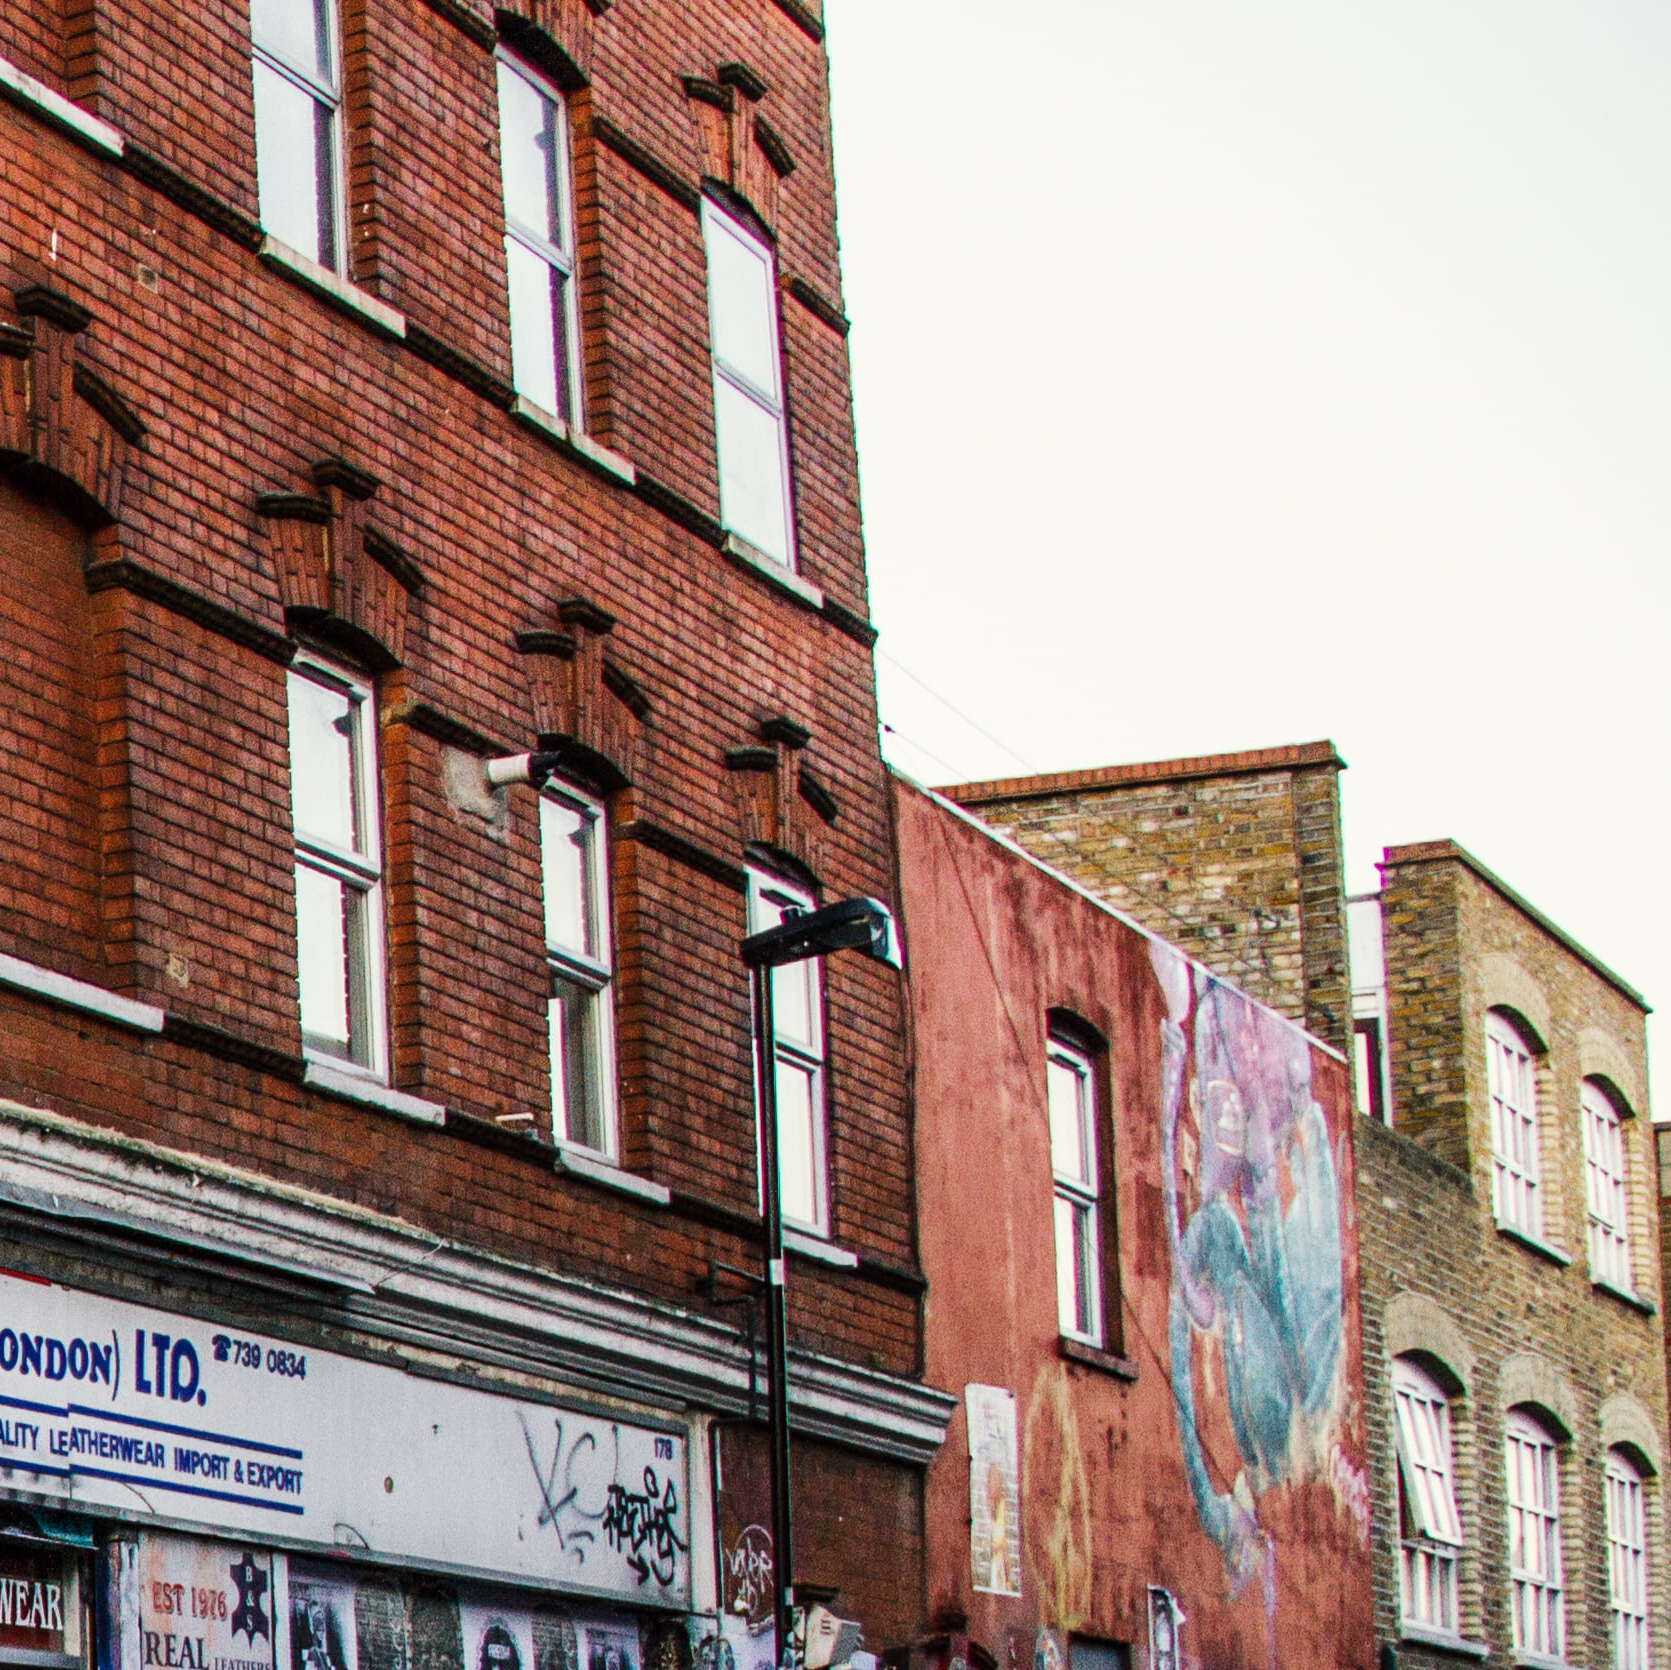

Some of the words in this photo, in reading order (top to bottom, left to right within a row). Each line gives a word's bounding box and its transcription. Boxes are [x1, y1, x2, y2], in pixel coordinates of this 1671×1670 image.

[134, 1328, 207, 1408] LTD.
[232, 1340, 260, 1369] 739
[266, 1349, 307, 1380] 0834
[49, 1423, 165, 1470] LEATHERWEAR
[174, 1447, 230, 1481] IMPORT
[234, 1459, 244, 1484] &
[247, 1461, 303, 1495] EXPORT
[655, 1437, 673, 1459] 178
[152, 1581, 183, 1616] EST
[191, 1587, 228, 1620] 1976
[144, 1631, 209, 1670] REAL
